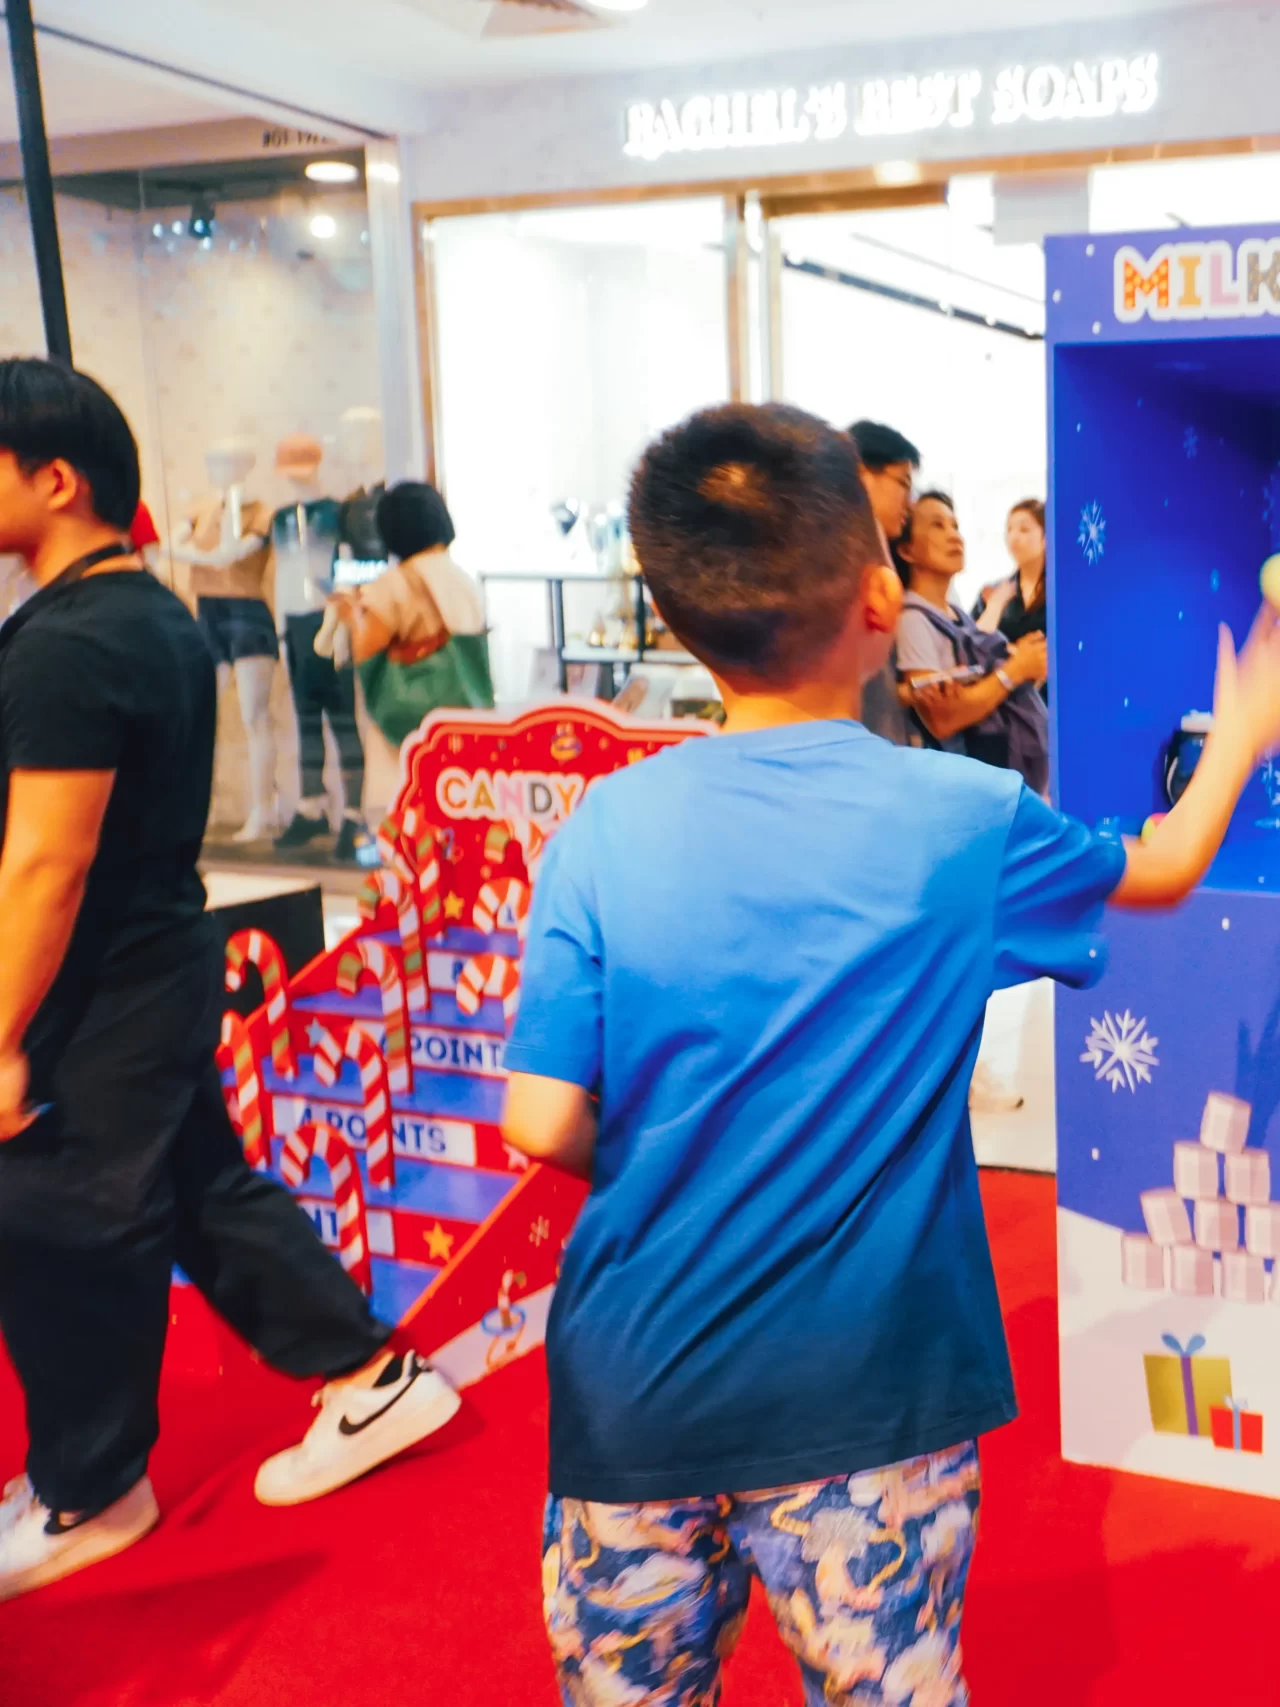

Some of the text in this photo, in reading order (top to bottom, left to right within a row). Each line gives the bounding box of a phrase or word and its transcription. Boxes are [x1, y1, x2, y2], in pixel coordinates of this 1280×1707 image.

[854, 70, 982, 136] BEST
[991, 53, 1158, 125] SOAPS
[442, 776, 577, 816] CANDY
[326, 1111, 446, 1153] PONTS
